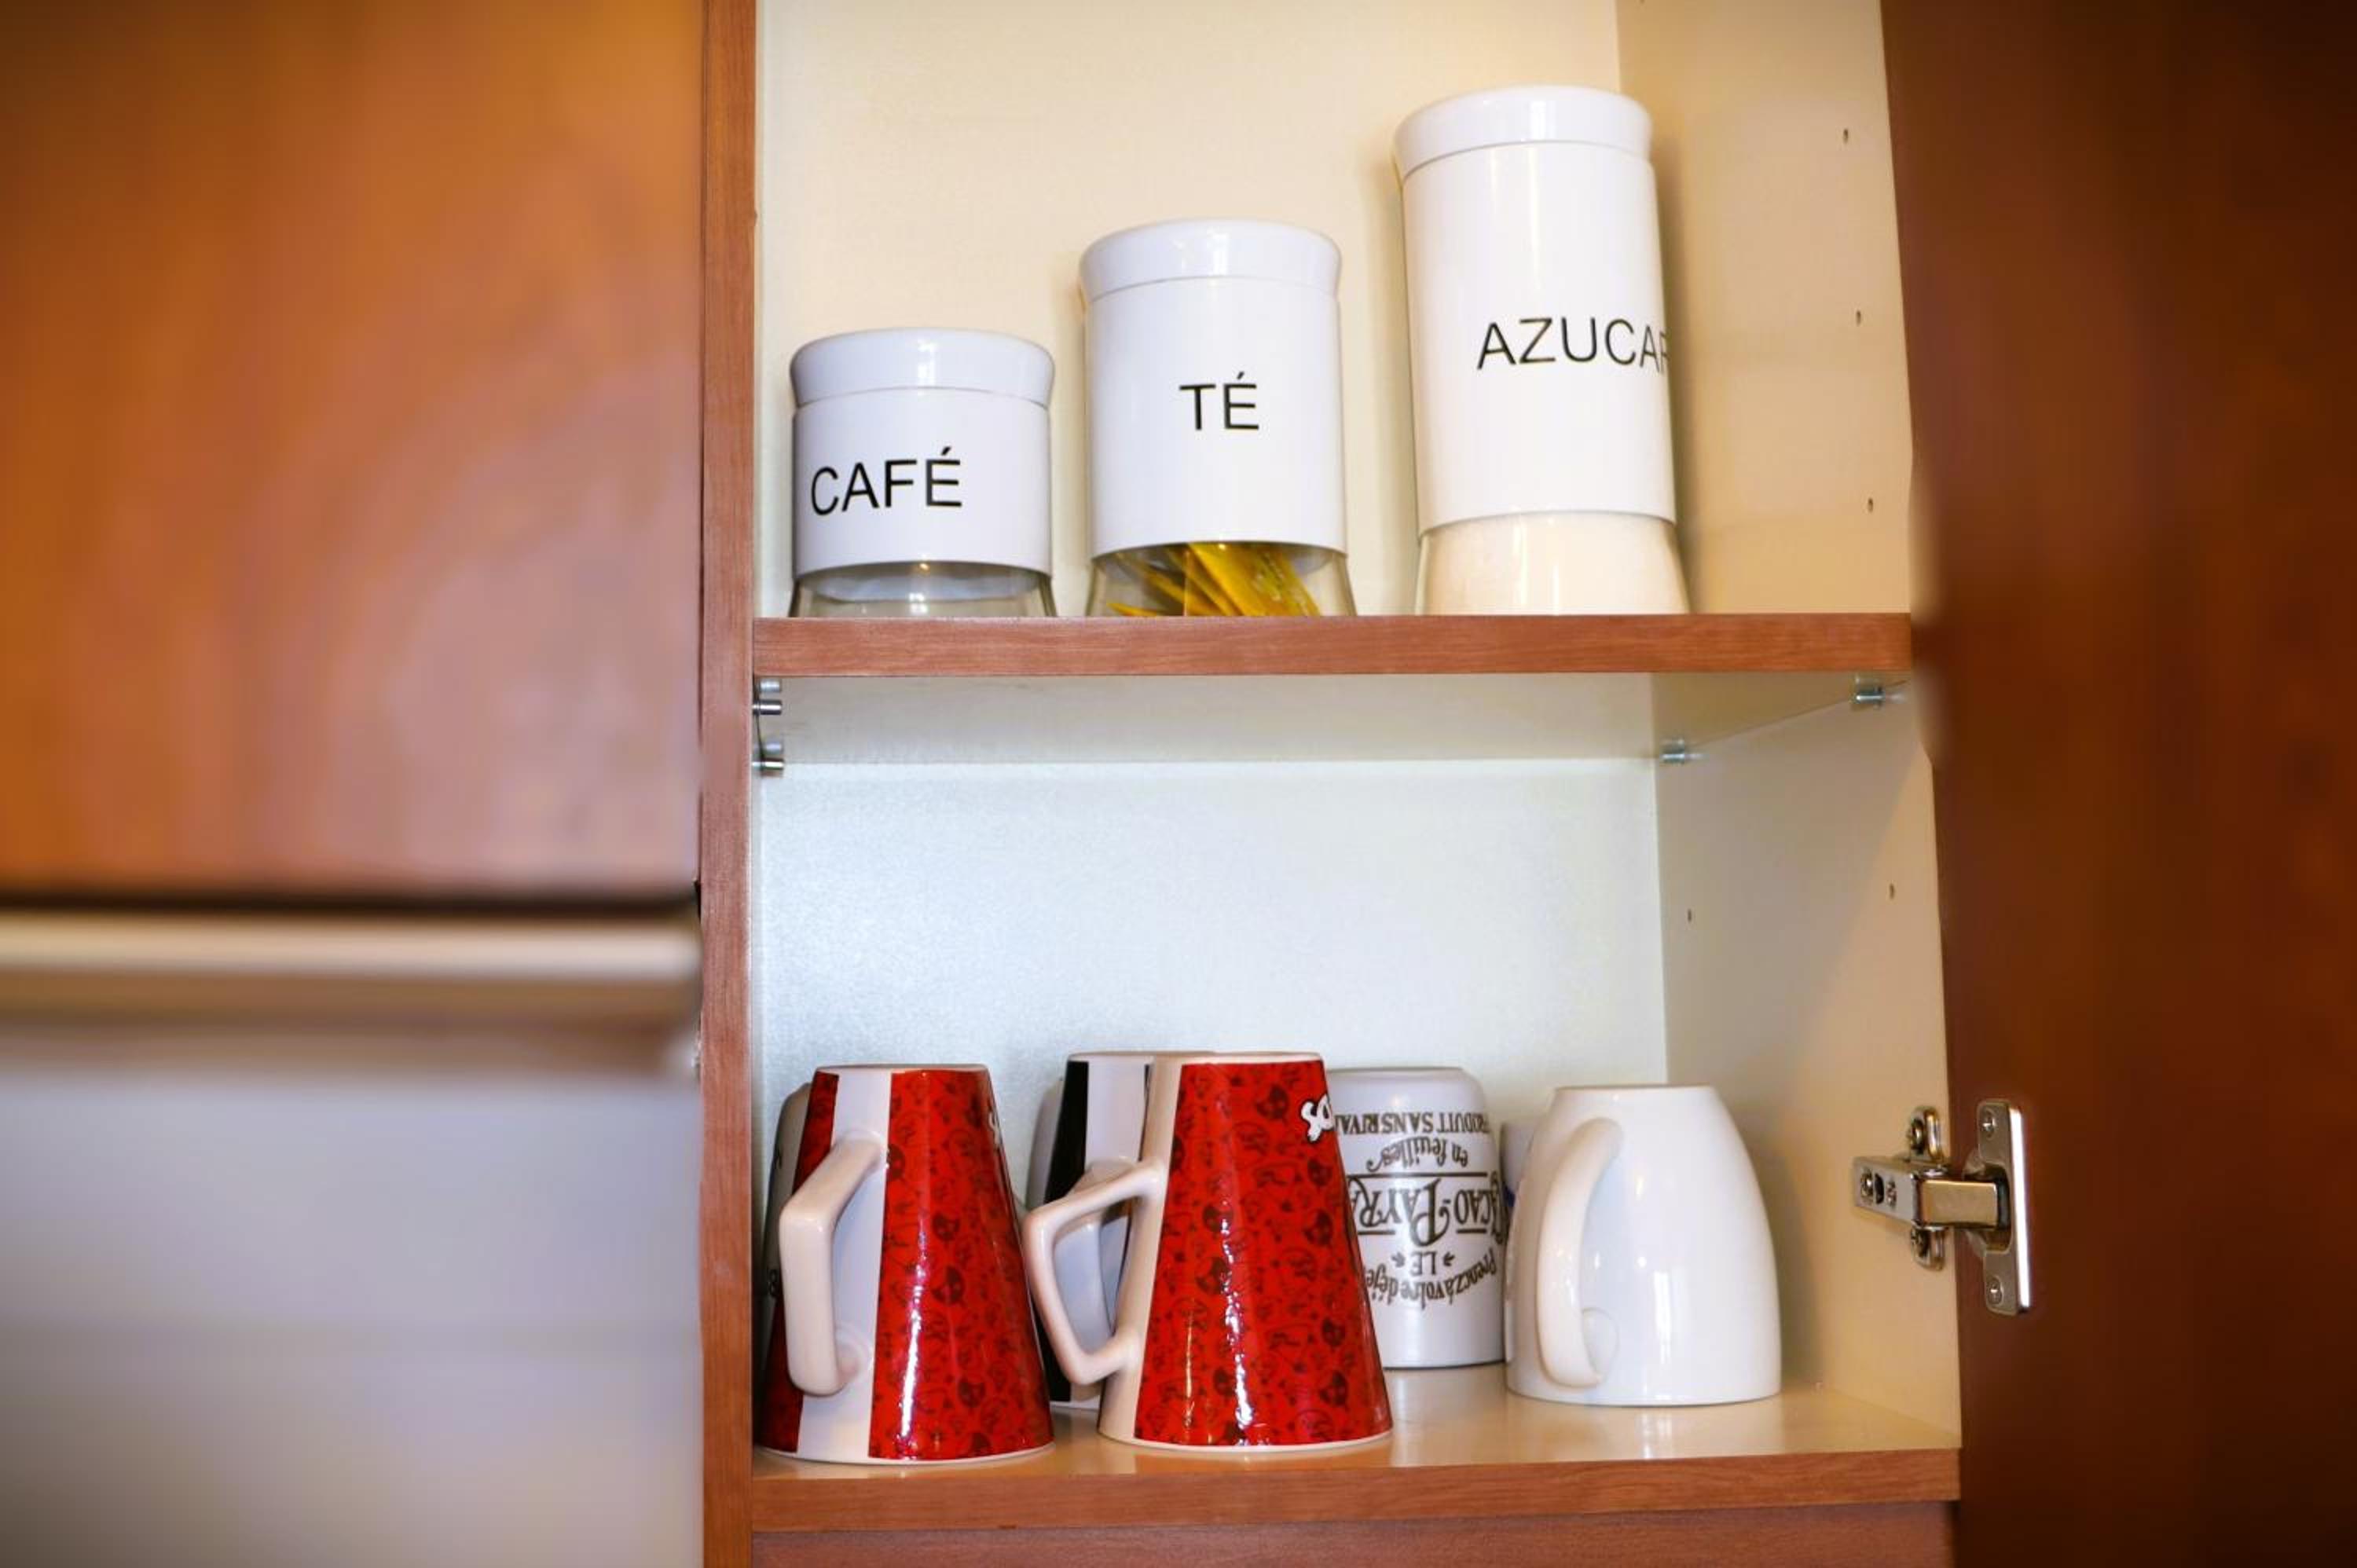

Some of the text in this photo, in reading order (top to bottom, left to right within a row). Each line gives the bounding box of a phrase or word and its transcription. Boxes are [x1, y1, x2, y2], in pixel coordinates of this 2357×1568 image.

[1178, 372, 1259, 430] TÉ
[810, 446, 962, 516] CAFÉ
[1382, 1112, 1434, 1134] SANS
[1365, 1135, 1468, 1172] en feuilles
[1410, 1251, 1437, 1277] LE
[1365, 1264, 1398, 1306] déje
